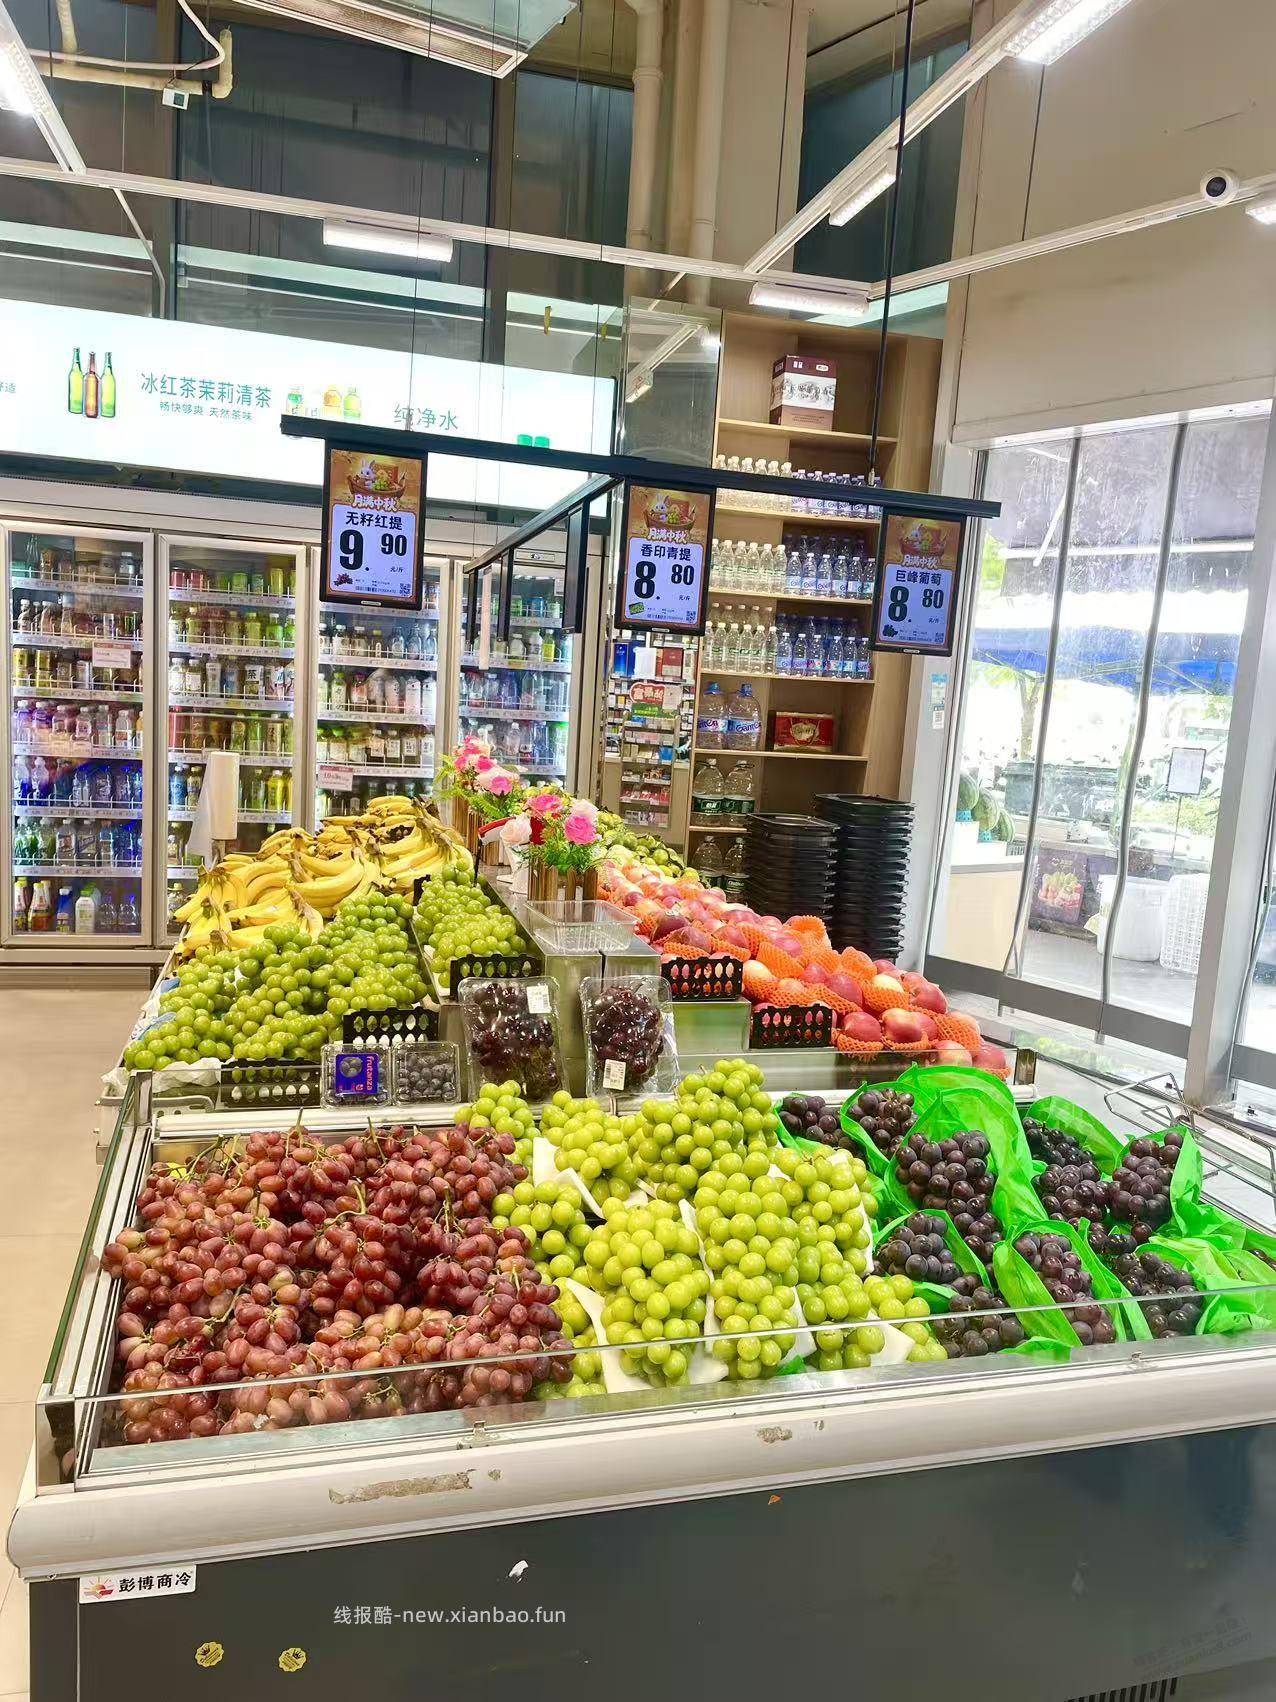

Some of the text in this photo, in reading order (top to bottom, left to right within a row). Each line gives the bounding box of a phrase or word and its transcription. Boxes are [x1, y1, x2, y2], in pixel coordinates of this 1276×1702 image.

[140, 371, 273, 410] 冰红茶茉莉清茶
[159, 400, 254, 422] 畅快够爽 天然茶味
[393, 403, 459, 431] 纯净水
[352, 494, 400, 513] 月满中秋
[345, 511, 403, 530] 无籽红提
[339, 529, 407, 572] 9. 90
[640, 543, 692, 562] 香印青提
[633, 561, 695, 600] 8. 80
[895, 569, 942, 587] 巨峰葡萄
[888, 585, 912, 623] 8.
[922, 588, 944, 609] 80
[247, 669, 257, 680] 茶
[118, 1571, 193, 1594] 彭博商冷
